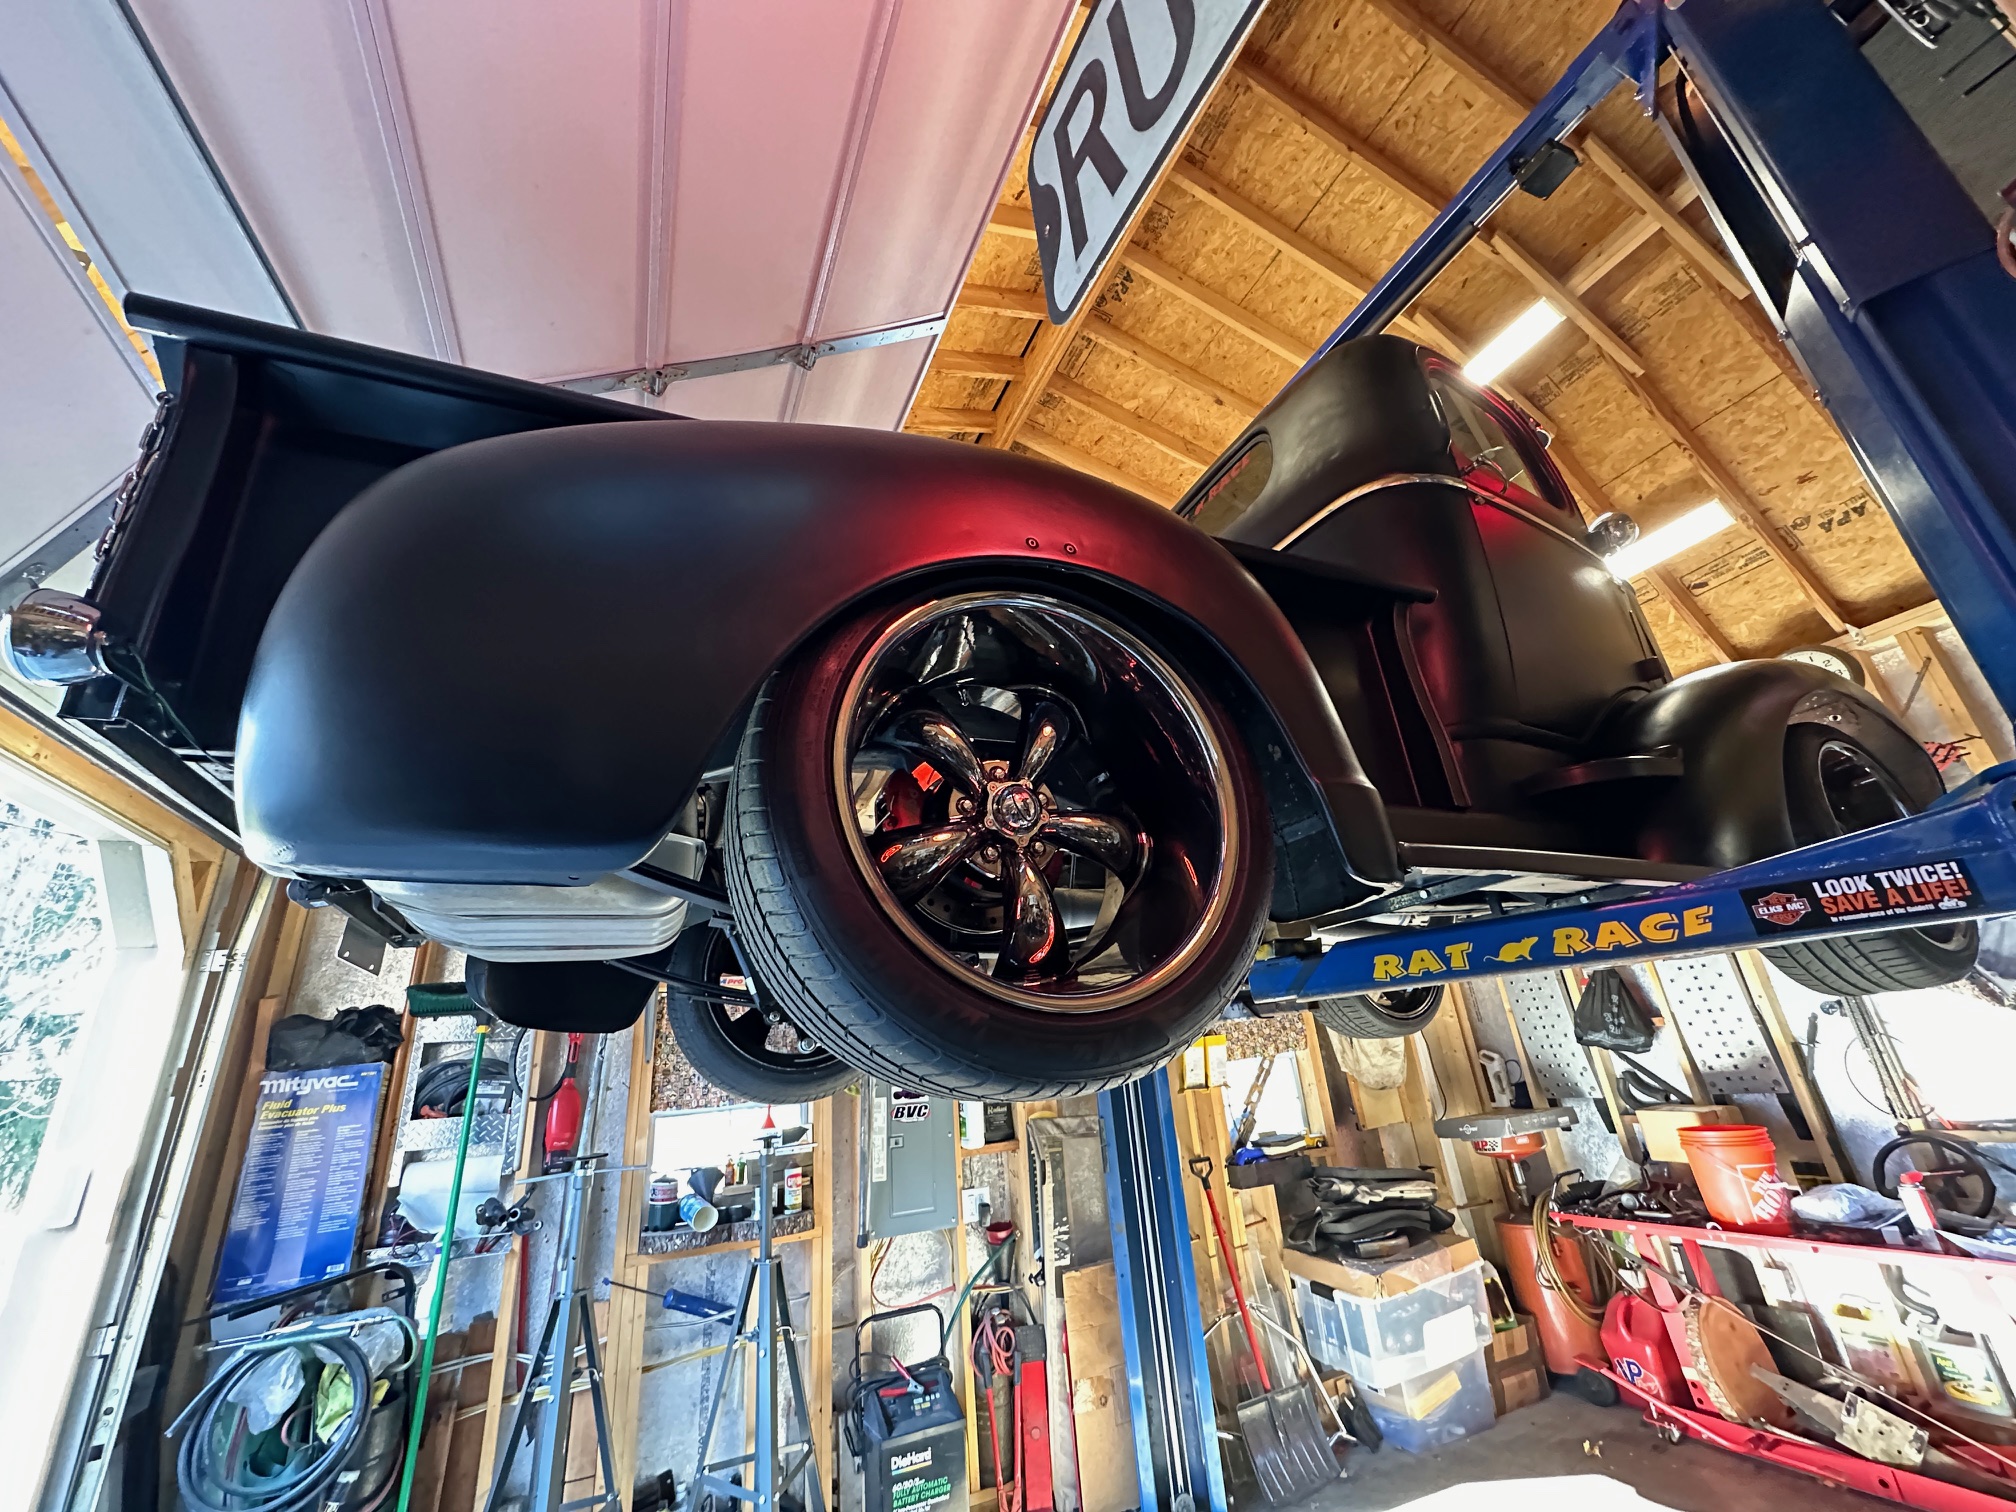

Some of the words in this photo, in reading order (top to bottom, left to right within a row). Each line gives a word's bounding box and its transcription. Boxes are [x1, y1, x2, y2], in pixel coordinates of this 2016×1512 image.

[1111, 269, 1134, 303] APA
[1817, 500, 1868, 534] APA
[1812, 874, 1875, 898] LOOK
[1873, 861, 1963, 889] TWICE!
[1758, 905, 1784, 915] ELKS
[1785, 901, 1805, 911] MC
[1820, 891, 1883, 915] SAVE
[1886, 888, 1907, 906] A
[1906, 879, 1973, 903] LIFE!
[1373, 941, 1473, 982] RAT
[1553, 905, 1713, 956] RACE
[259, 1106, 320, 1120] Evacuator
[320, 1103, 347, 1114] Plus
[261, 1099, 294, 1111] Fluid
[893, 1104, 930, 1119] BVC
[891, 1447, 932, 1470] DieHard
[893, 1486, 911, 1500] FULLY
[911, 1476, 948, 1494] AUTOMATIC
[893, 1492, 920, 1508] BATTERY
[921, 1483, 952, 1499] CHARGER
